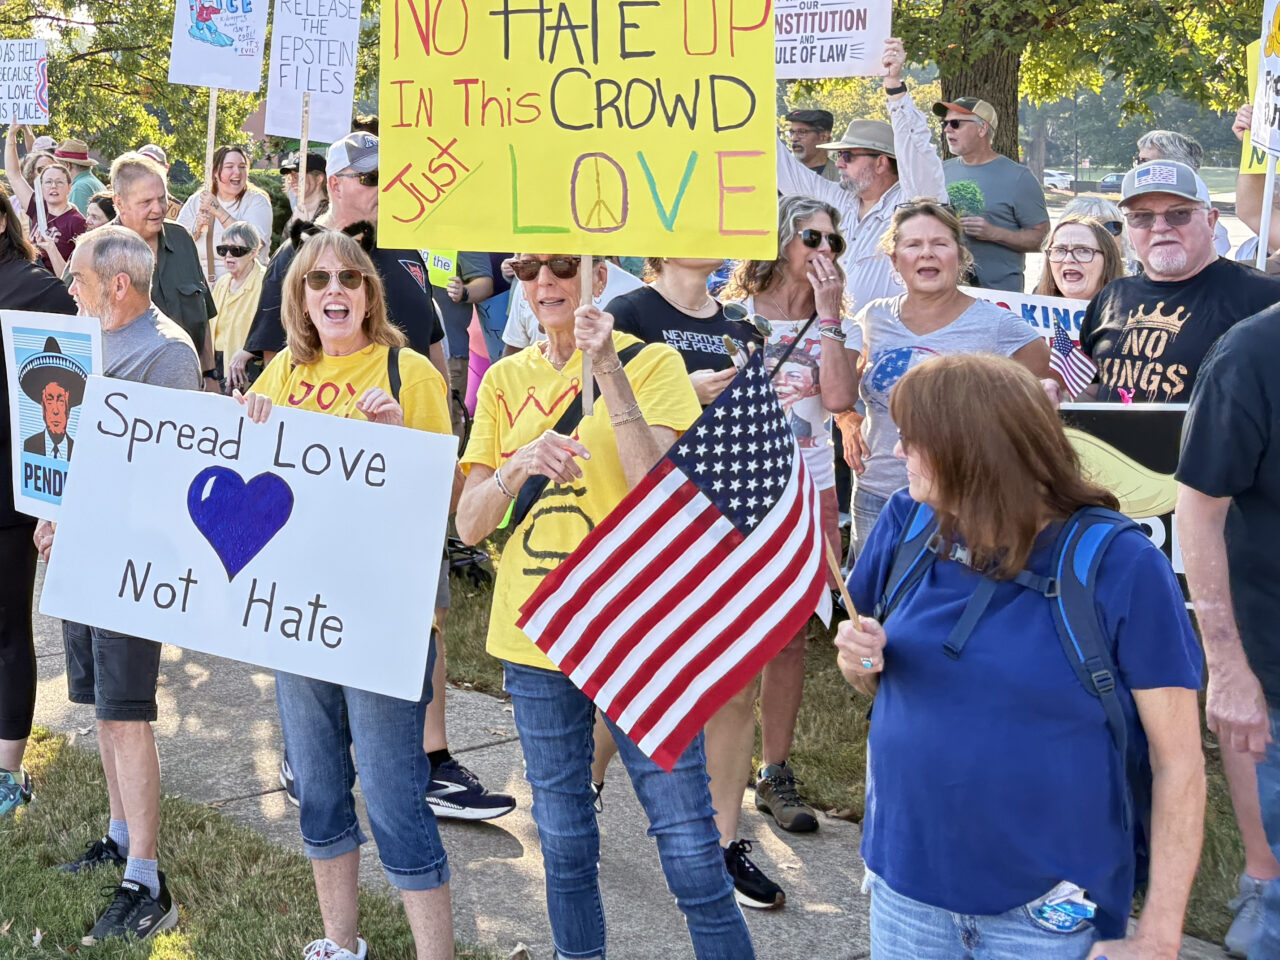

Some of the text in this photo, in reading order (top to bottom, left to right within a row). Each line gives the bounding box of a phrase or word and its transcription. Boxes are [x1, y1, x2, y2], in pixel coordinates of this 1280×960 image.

[799, 1, 819, 10] OUR
[301, 18, 328, 35] THE
[775, 8, 867, 35] NSTITUTION
[4, 42, 16, 62] AS
[280, 35, 354, 67] EPSTEIN
[775, 44, 847, 64] ULE OF LAW
[800, 35, 815, 45] AND
[8, 85, 33, 100] LOVE
[280, 63, 344, 95] FILES
[13, 103, 41, 120] PLACE
[390, 68, 756, 133] IN This CROWD
[509, 143, 771, 236] LOVE
[1021, 302, 1087, 333] KING
[662, 329, 745, 349] NEVERTHESS
[666, 340, 693, 351] SHE
[1121, 328, 1168, 361] NO
[1097, 357, 1188, 397] KINGS
[288, 380, 357, 411] JOY
[97, 392, 387, 488] Spread Love
[118, 558, 344, 649] Not Hate
